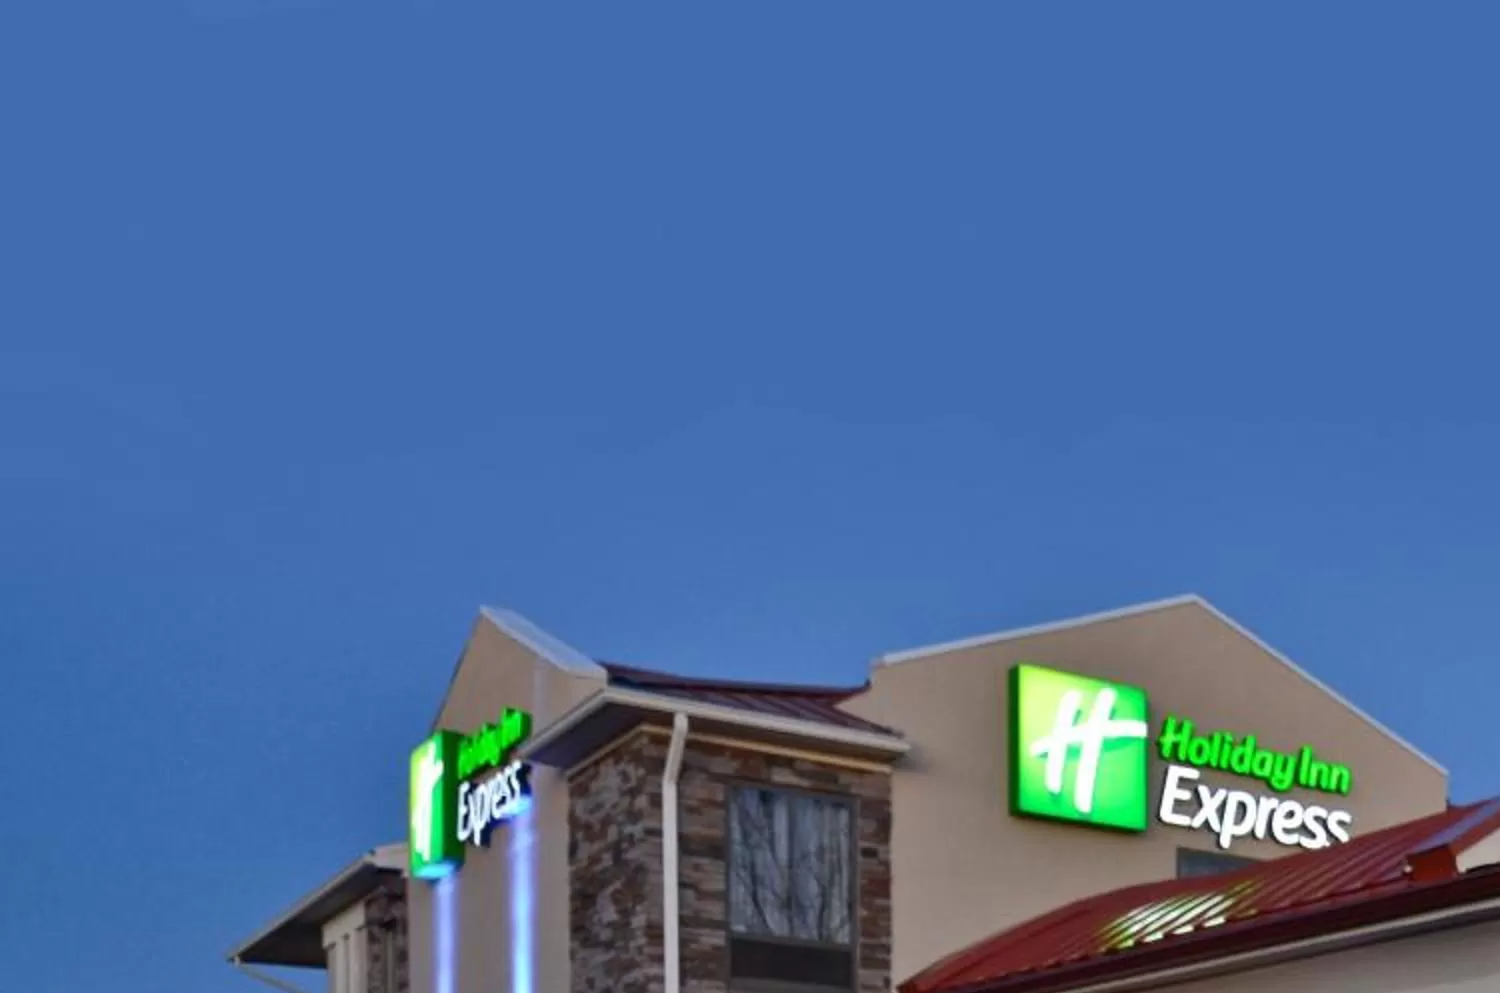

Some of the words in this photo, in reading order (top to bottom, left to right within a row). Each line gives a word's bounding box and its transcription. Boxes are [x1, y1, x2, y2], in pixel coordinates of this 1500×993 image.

[1160, 715, 1296, 791] Holiday
[1298, 745, 1353, 794] Inn
[1158, 765, 1353, 849] Express
